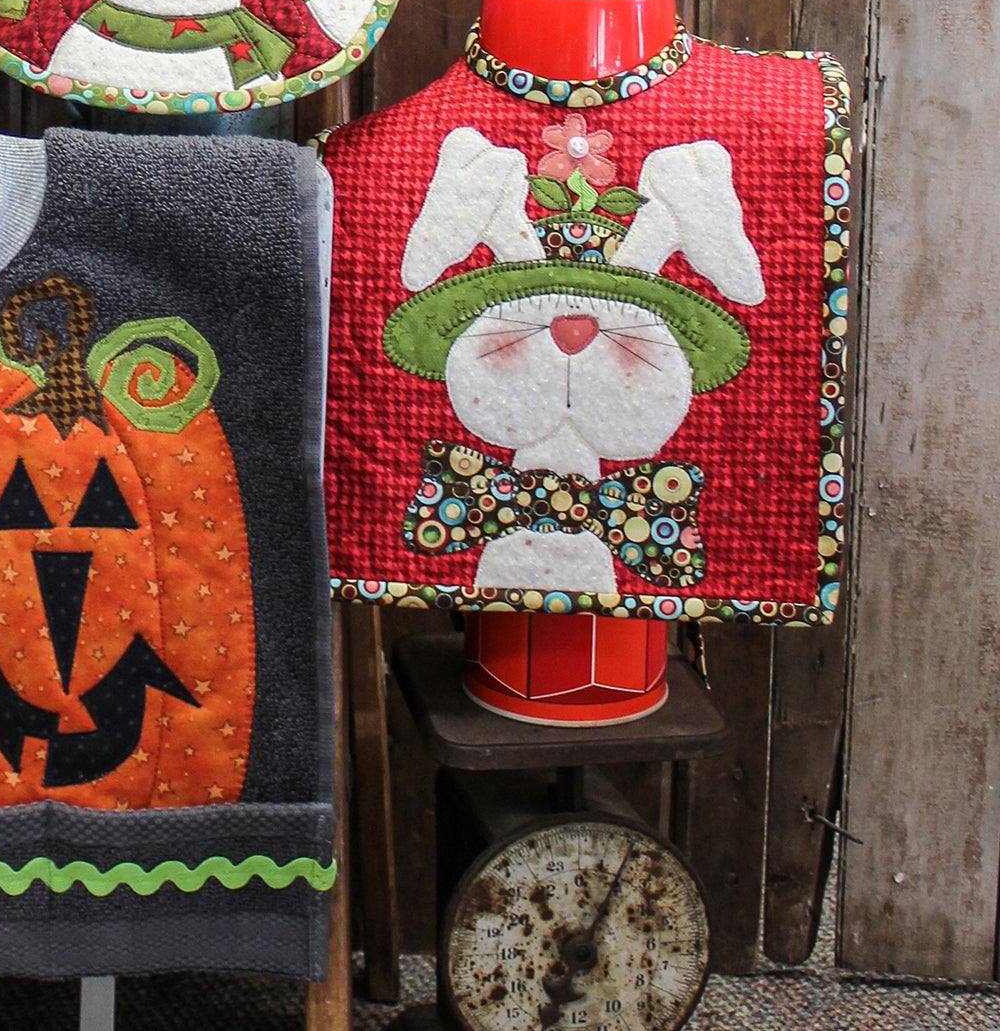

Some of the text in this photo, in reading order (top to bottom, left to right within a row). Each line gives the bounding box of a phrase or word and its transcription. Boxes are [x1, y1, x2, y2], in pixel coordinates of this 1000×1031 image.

[546, 861, 565, 872] 23
[487, 928, 500, 938] 19
[646, 937, 656, 951] 6
[501, 947, 518, 961] 18
[661, 960, 669, 971] 7
[511, 980, 527, 993] 16
[635, 974, 645, 987] 8
[605, 999, 622, 1013] 10
[506, 1008, 520, 1019] 15
[571, 1010, 588, 1024] 12
